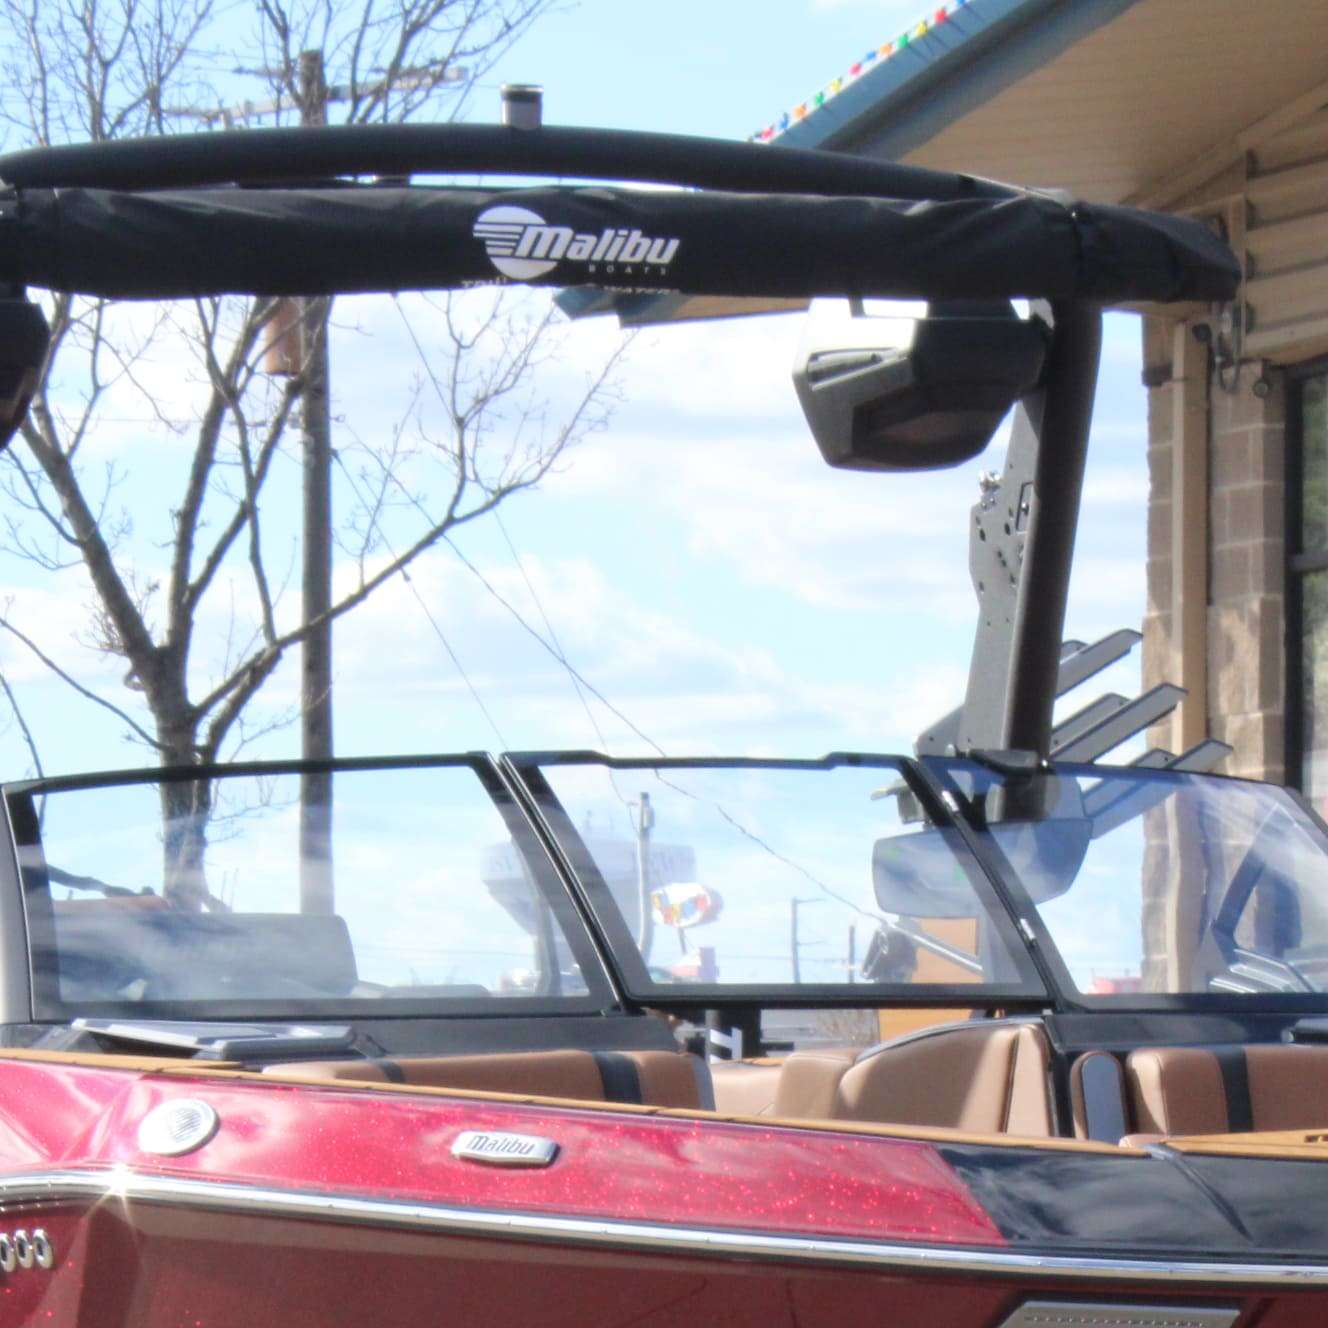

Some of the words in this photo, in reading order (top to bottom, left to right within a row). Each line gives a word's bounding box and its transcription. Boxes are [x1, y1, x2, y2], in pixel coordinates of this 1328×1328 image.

[515, 226, 680, 264] Malibu
[588, 264, 667, 276] BOATS
[467, 1134, 536, 1155] Malibu
